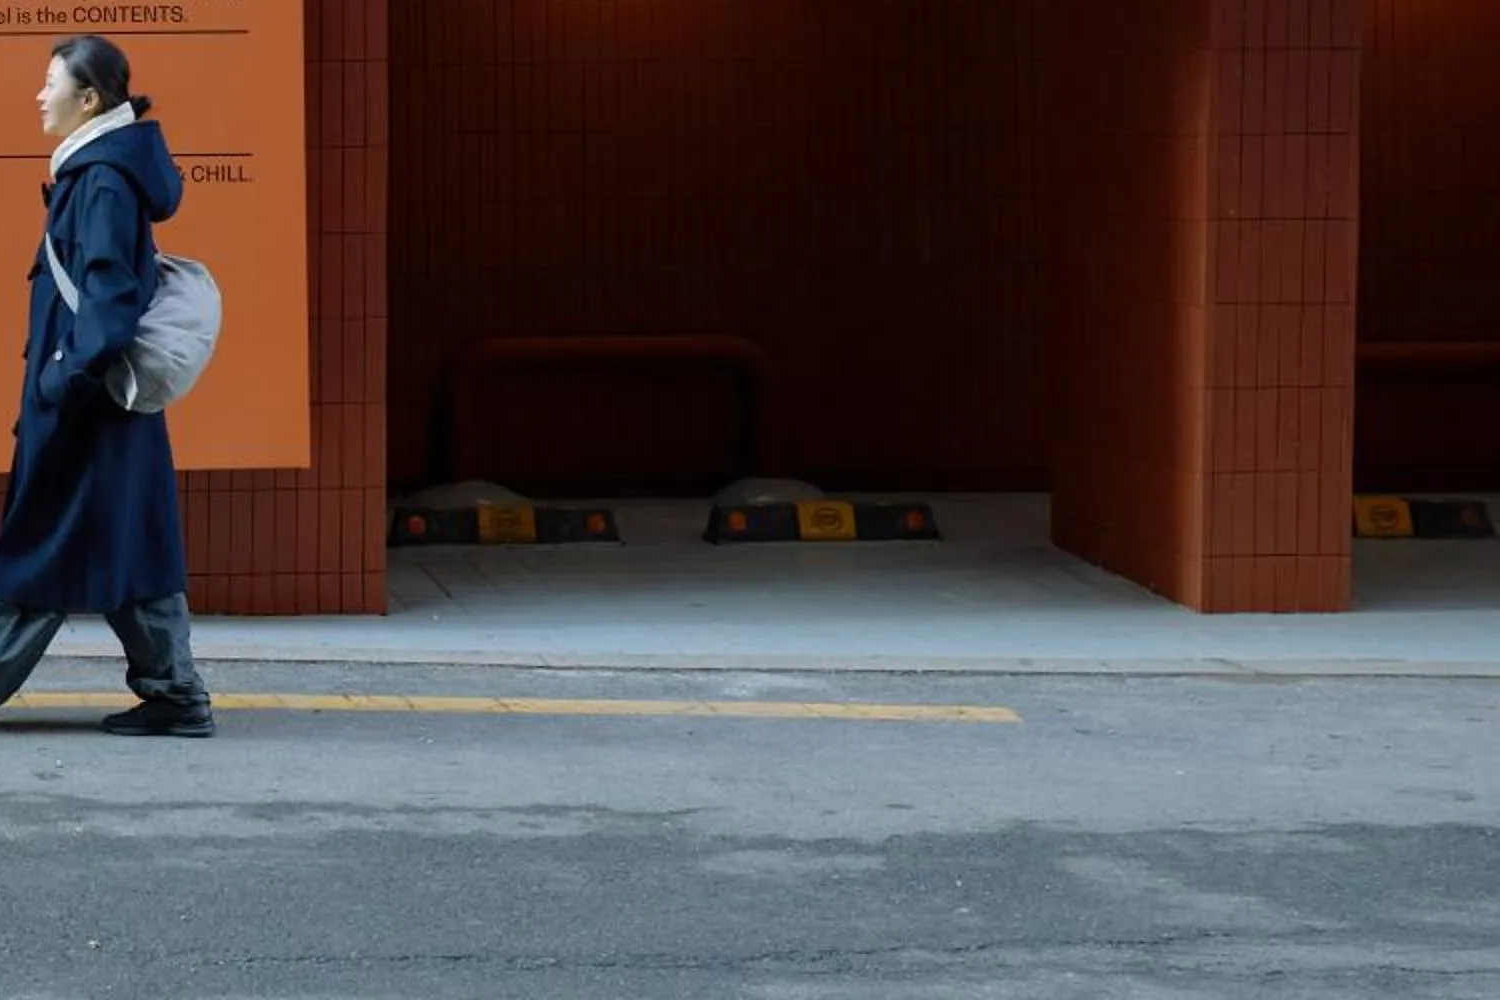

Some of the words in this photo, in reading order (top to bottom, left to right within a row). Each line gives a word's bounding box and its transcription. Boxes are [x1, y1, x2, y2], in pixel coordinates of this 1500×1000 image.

[16, 7, 32, 24] is
[36, 6, 68, 24] the
[72, 5, 188, 23] CONTENTS.
